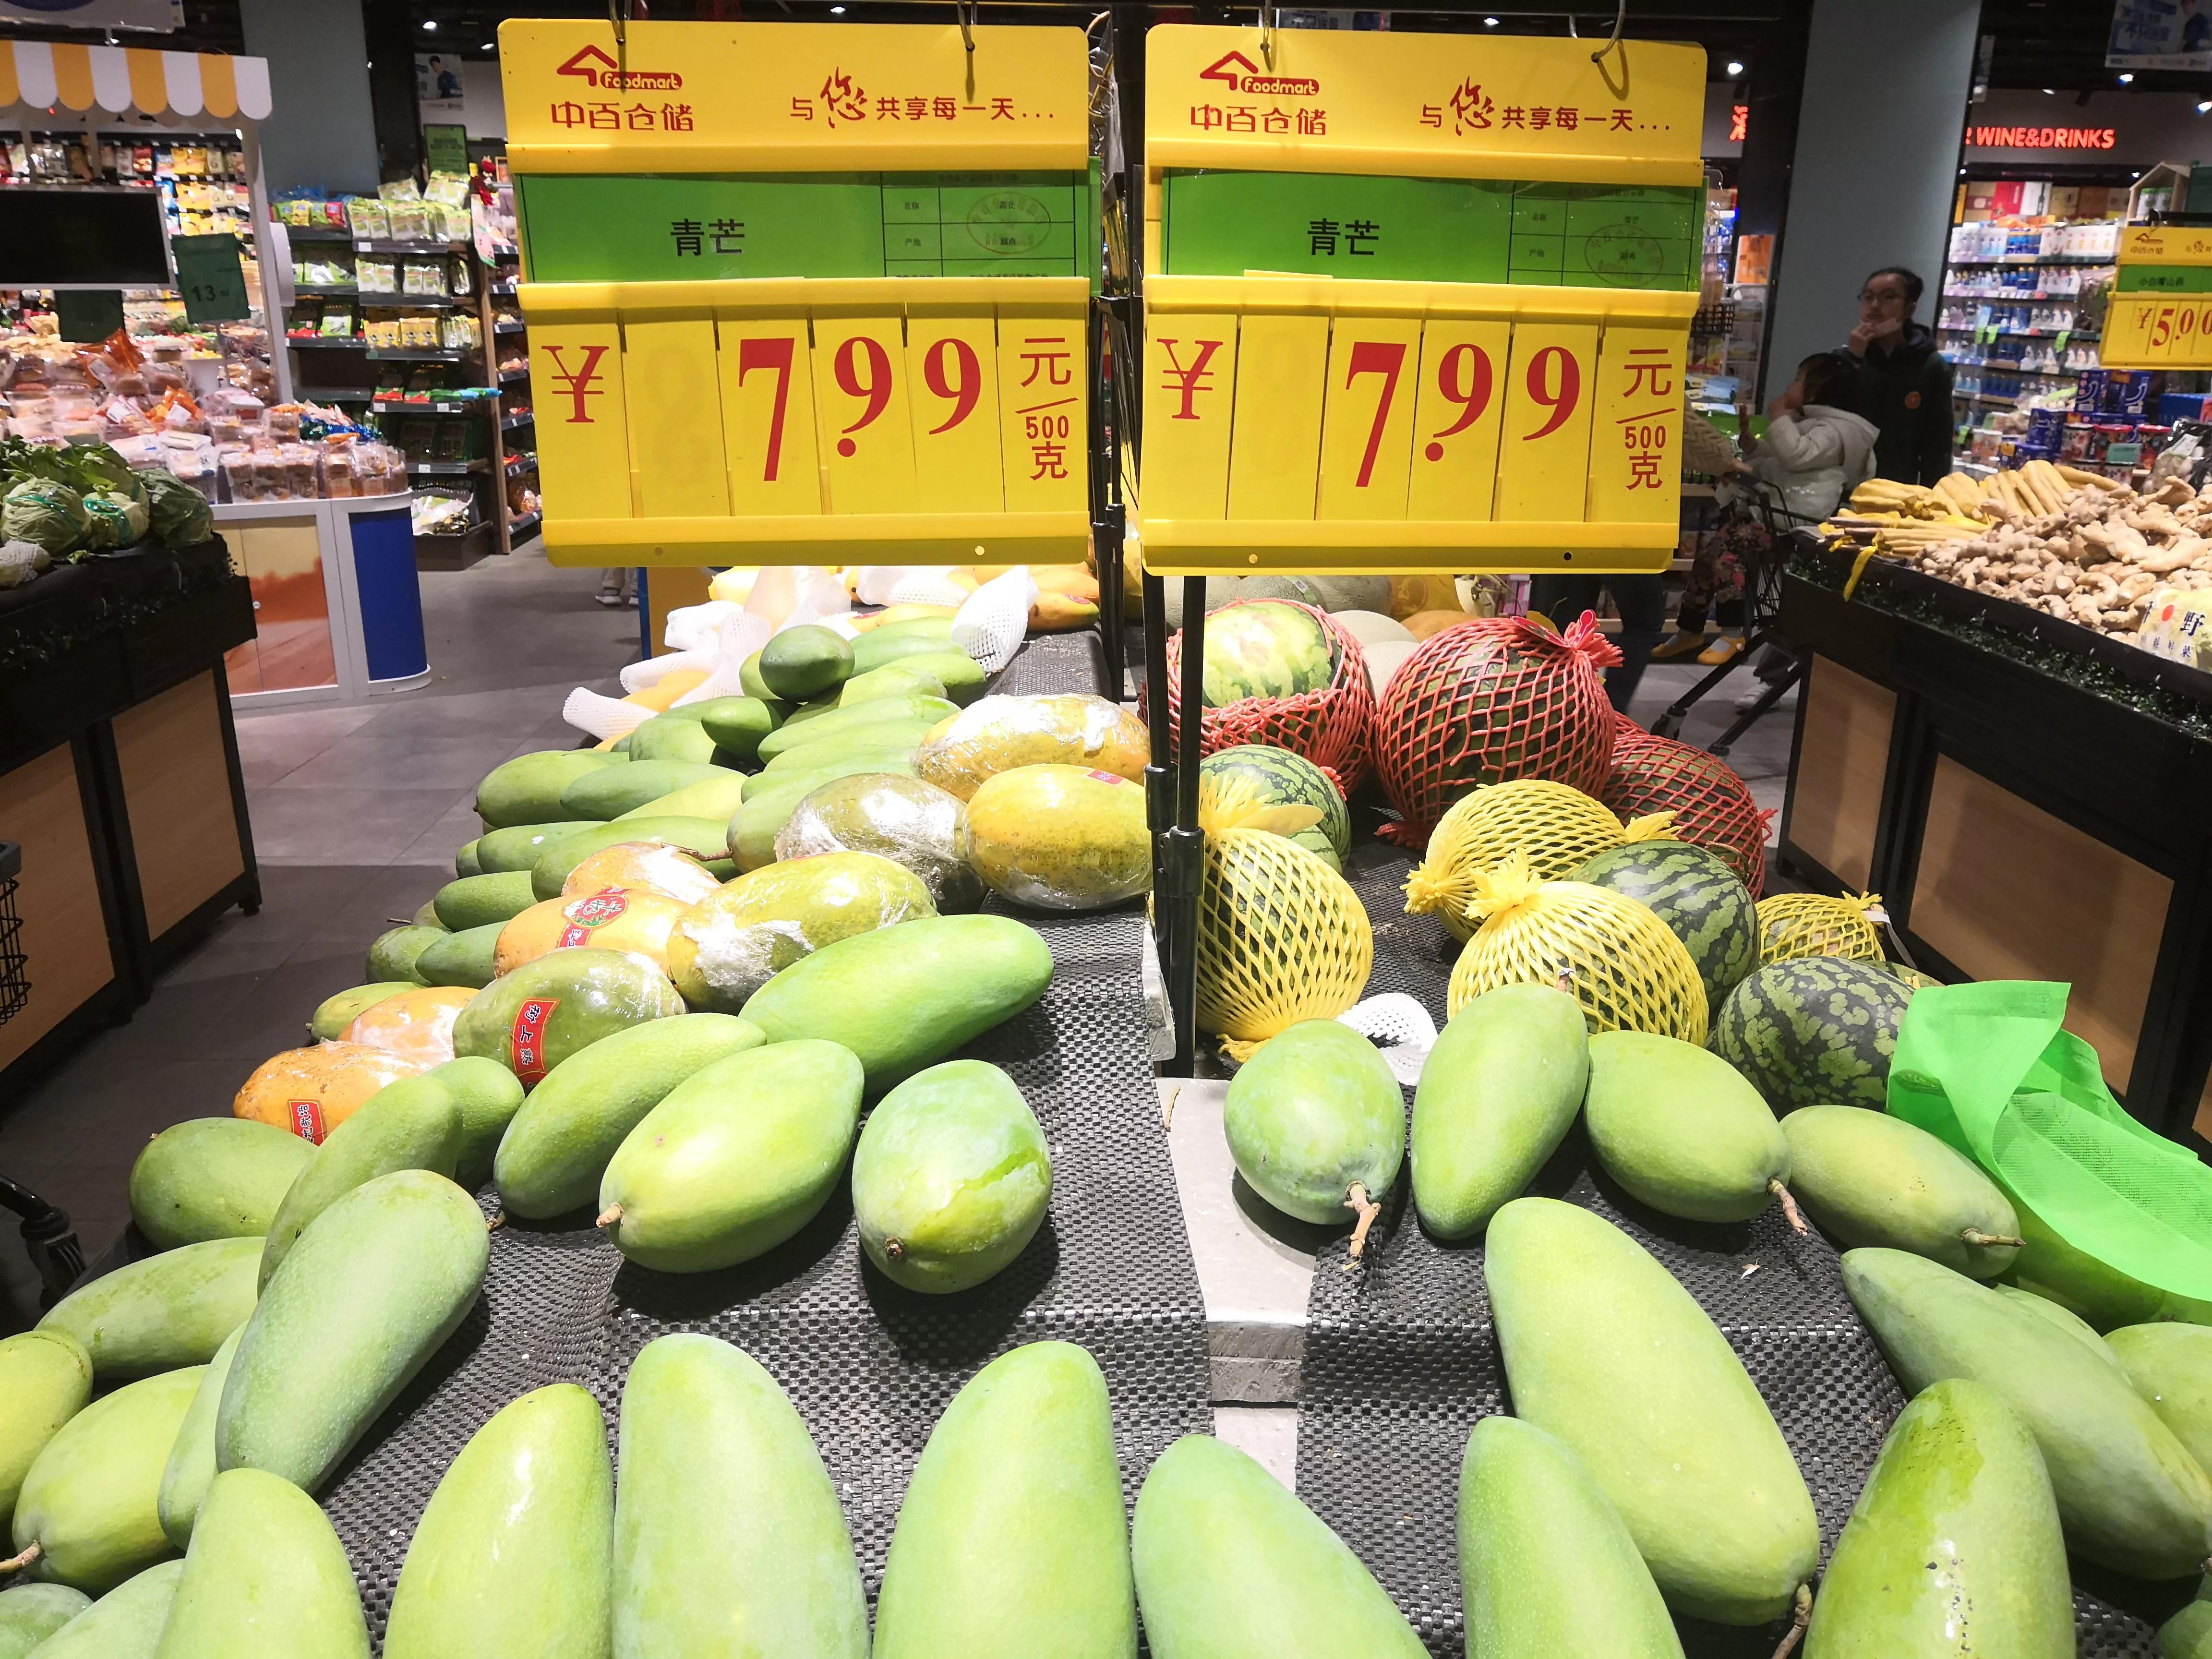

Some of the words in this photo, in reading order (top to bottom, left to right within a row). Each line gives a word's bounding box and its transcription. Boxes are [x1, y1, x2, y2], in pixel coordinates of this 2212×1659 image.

[604, 72, 680, 90] Foodmart
[1245, 77, 1317, 95] Foodmart
[552, 101, 693, 131] 中百仓储
[1190, 104, 1326, 135] 中百仓储
[1976, 126, 2116, 149] WINE&DRINKS
[671, 218, 745, 256] 青芒
[1307, 218, 1380, 256] 青芒
[520, 1004, 541, 1065] 树上熟
